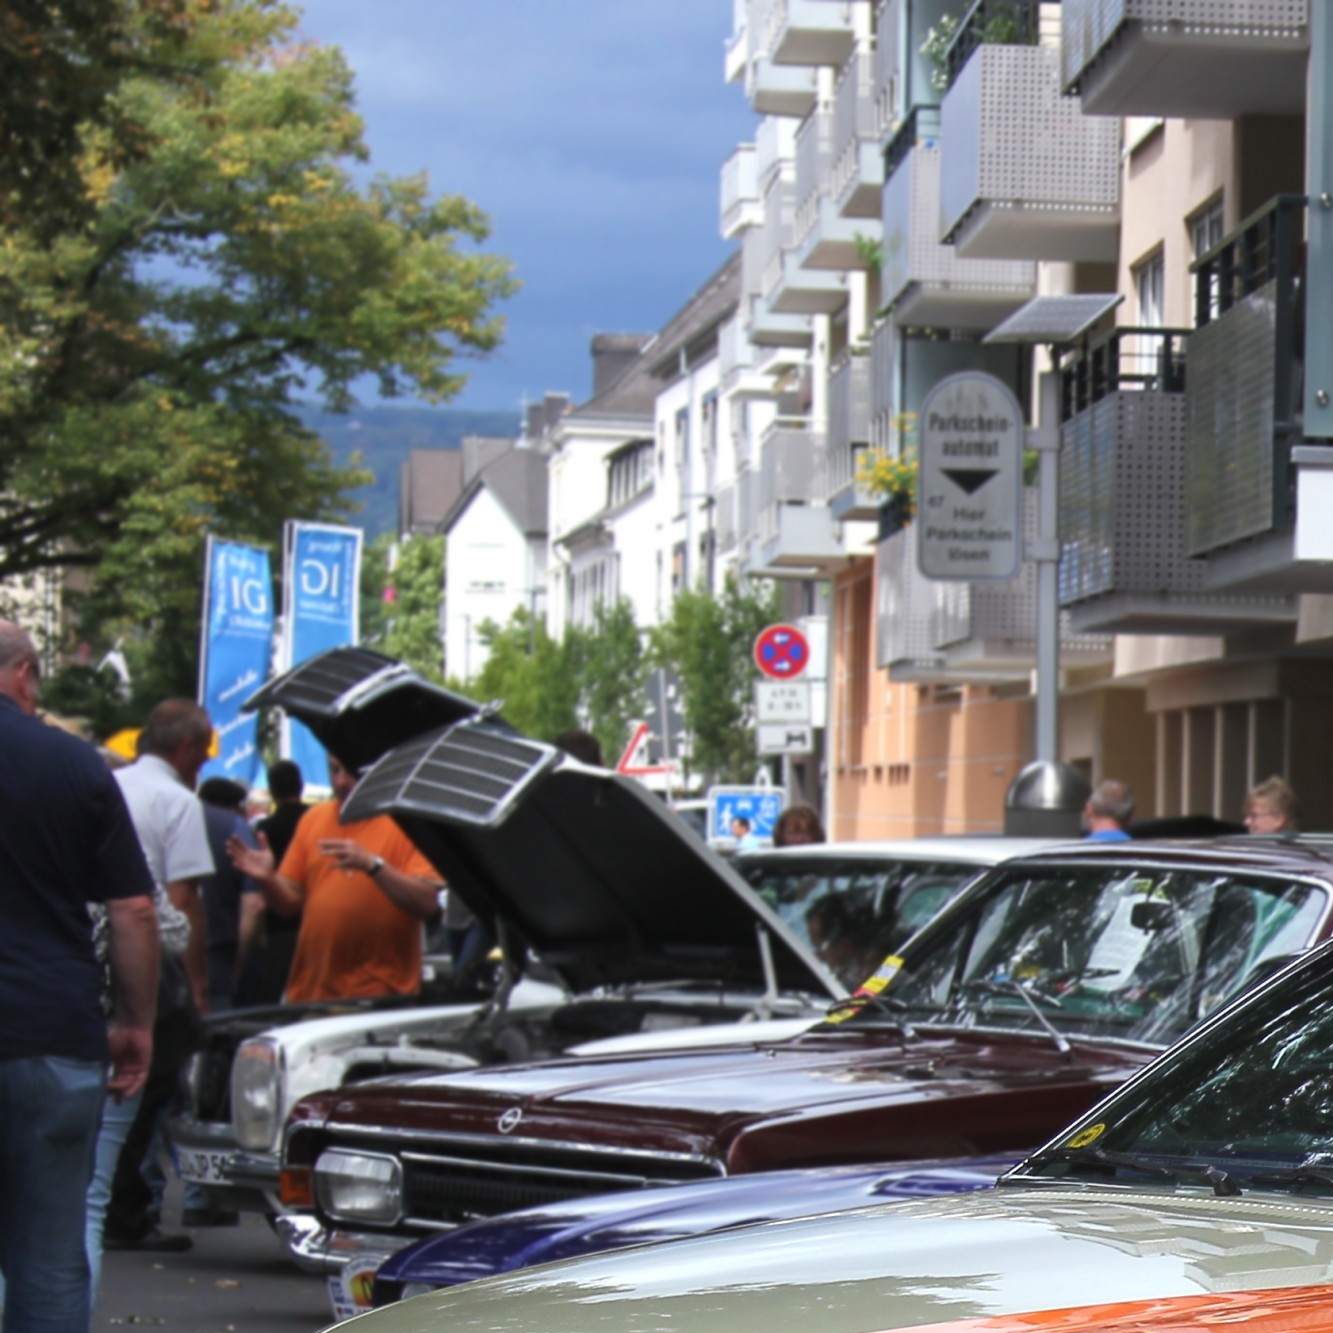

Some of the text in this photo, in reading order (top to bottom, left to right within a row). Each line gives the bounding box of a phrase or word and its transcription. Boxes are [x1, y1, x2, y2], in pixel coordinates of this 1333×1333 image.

[929, 412, 1014, 432] Parkschein-
[942, 439, 999, 456] automat
[953, 507, 986, 521] Hier
[926, 526, 1013, 542] Parkschein
[948, 546, 990, 562] lösen
[231, 575, 268, 616] IG
